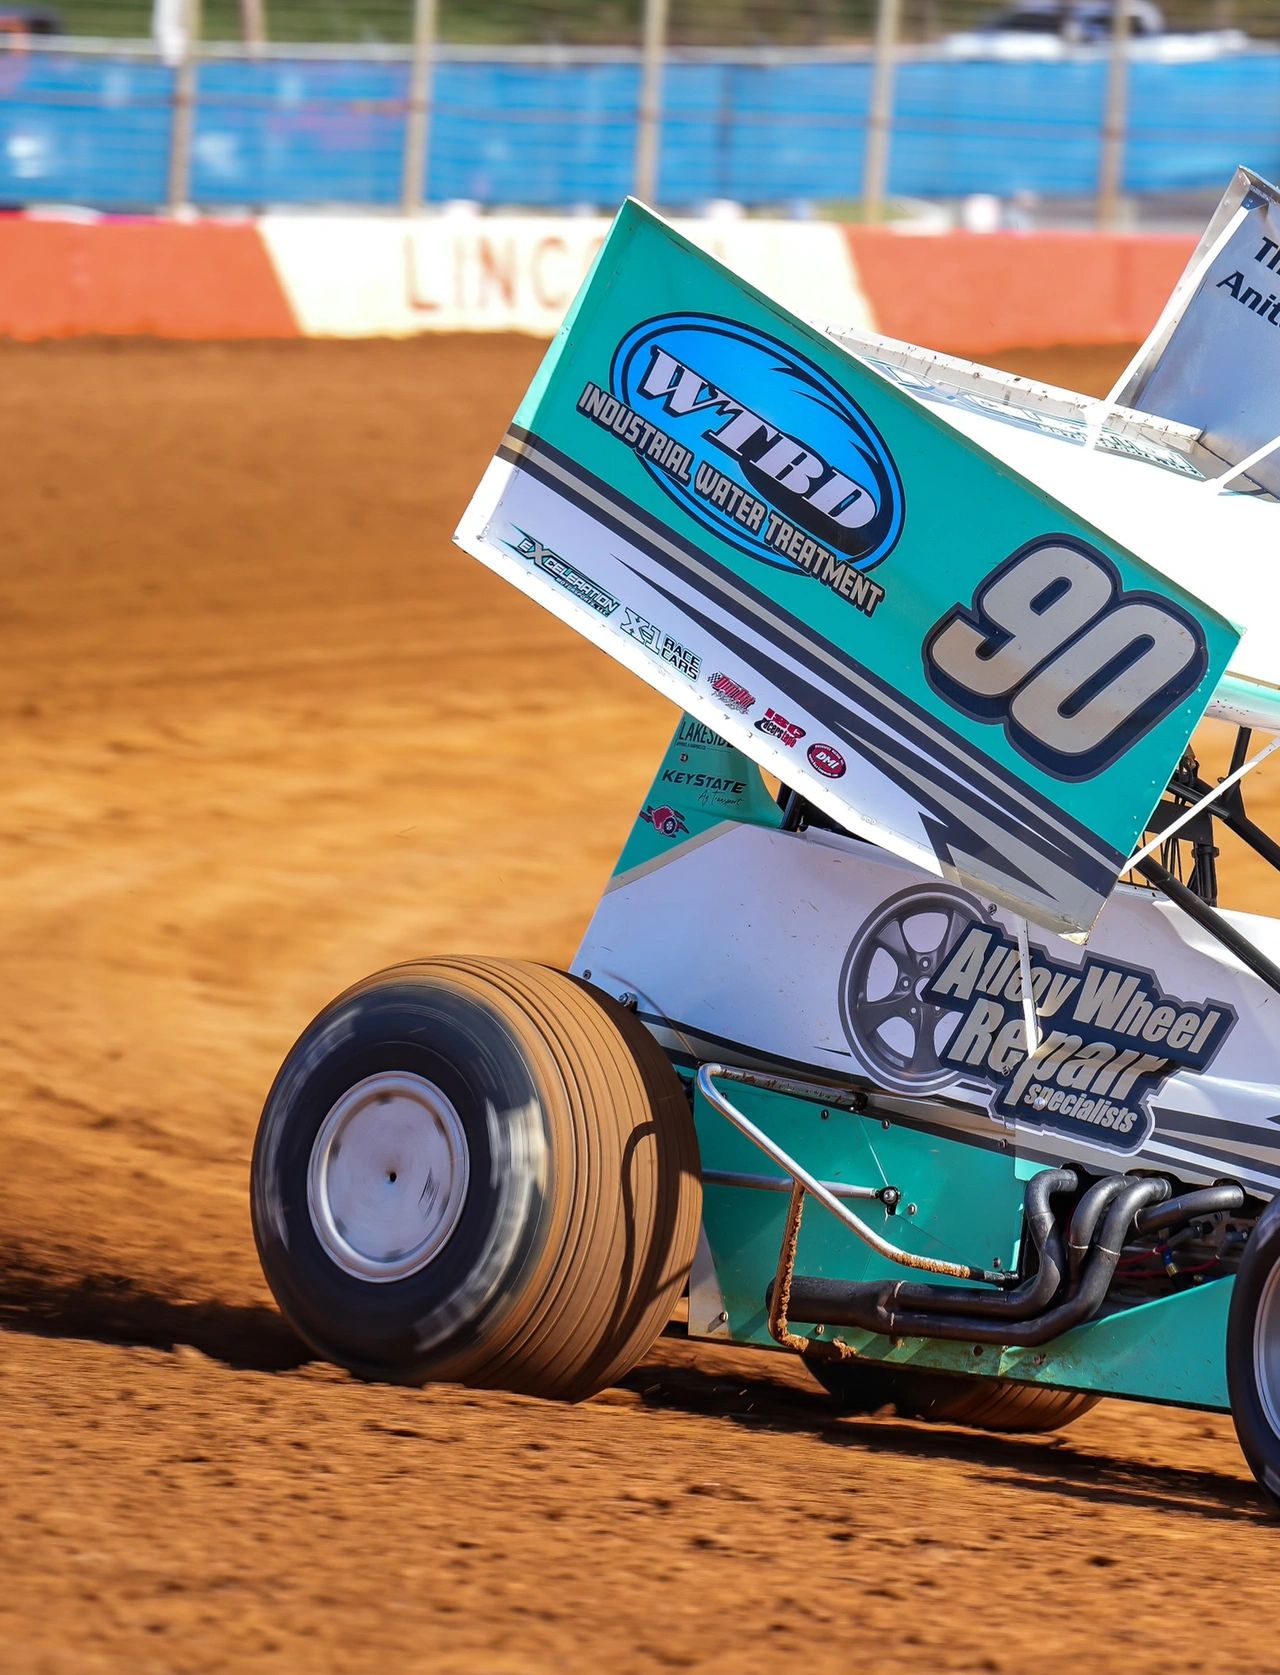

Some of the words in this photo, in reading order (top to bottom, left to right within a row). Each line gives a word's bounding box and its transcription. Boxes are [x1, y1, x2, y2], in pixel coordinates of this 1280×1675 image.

[641, 346, 877, 530] WTBD
[577, 382, 695, 483] INDUSTRIAL
[694, 461, 767, 533] WATER
[765, 511, 885, 614] TREATMENT
[661, 647, 699, 680] CARS
[663, 634, 701, 667] RACE
[927, 540, 1202, 768] 90
[678, 720, 735, 748] LAKESI
[815, 751, 840, 769] DMI
[662, 769, 748, 794] KEYSTATE
[931, 927, 1082, 1018] Alloy
[1072, 965, 1222, 1055] Wheel
[947, 998, 1170, 1107] Repair
[1023, 1081, 1137, 1133] specialists
